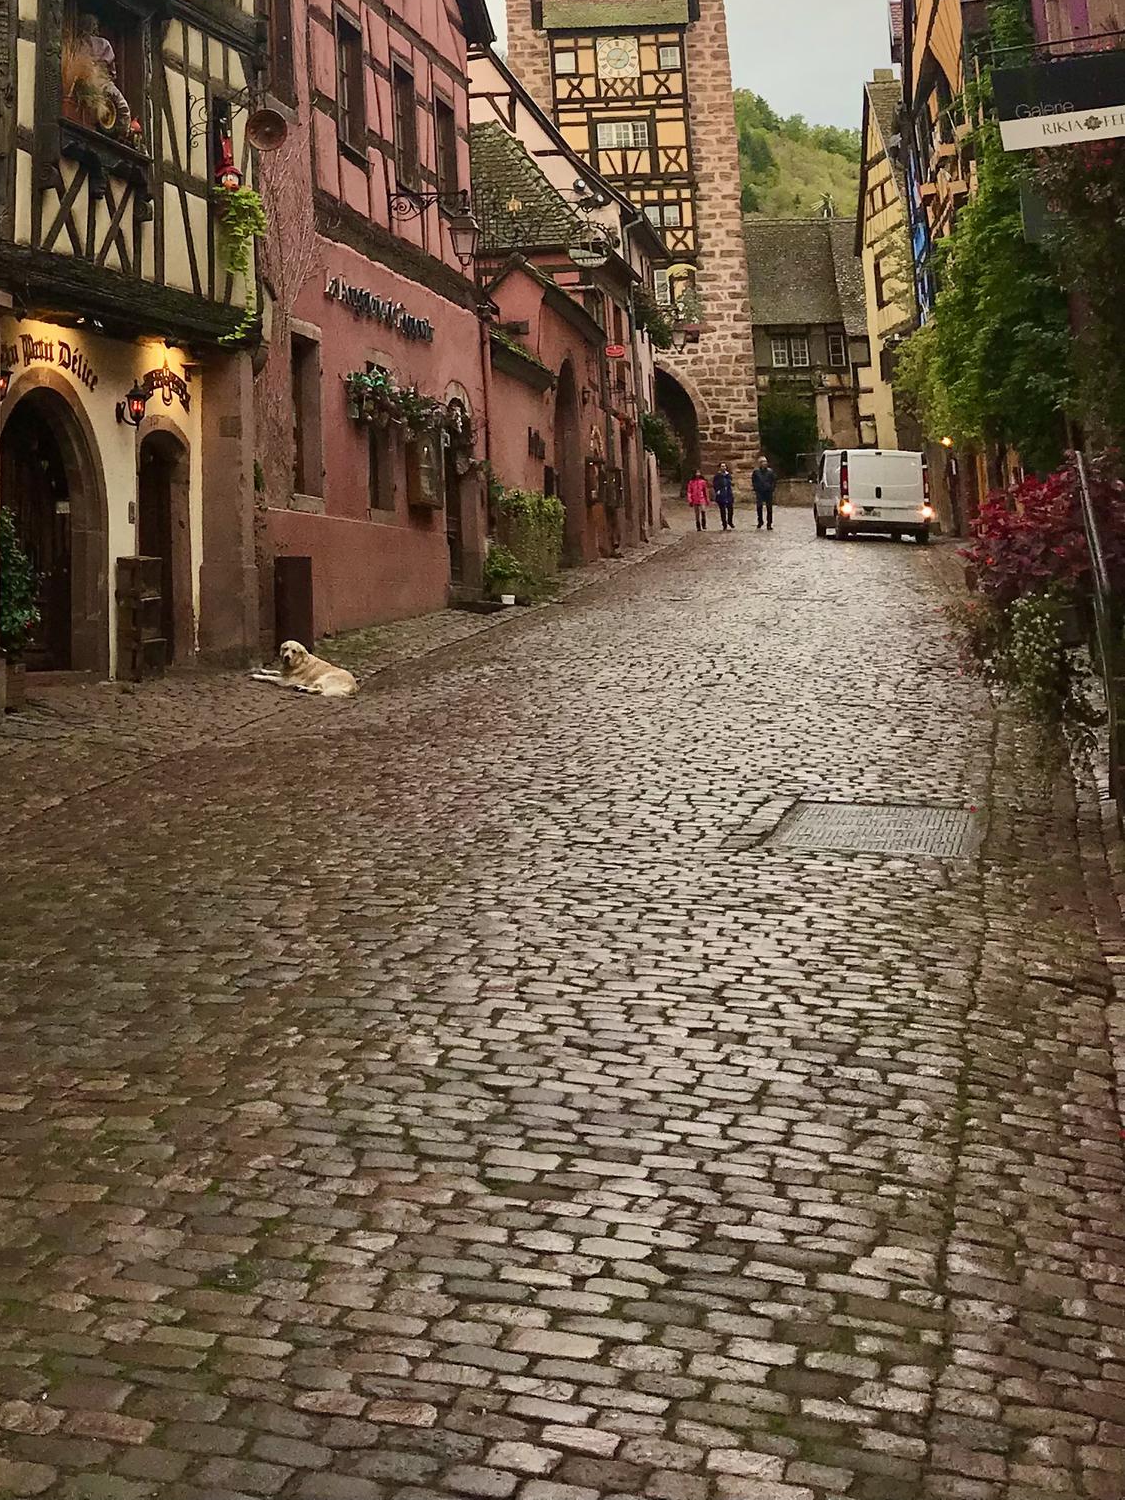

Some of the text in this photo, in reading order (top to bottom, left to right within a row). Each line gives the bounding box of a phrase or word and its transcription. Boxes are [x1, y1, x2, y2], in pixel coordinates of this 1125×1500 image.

[1015, 101, 1074, 119] Galerie
[1042, 120, 1083, 135] RIKIA
[19, 333, 55, 368] Petit
[57, 339, 99, 393] Délice
